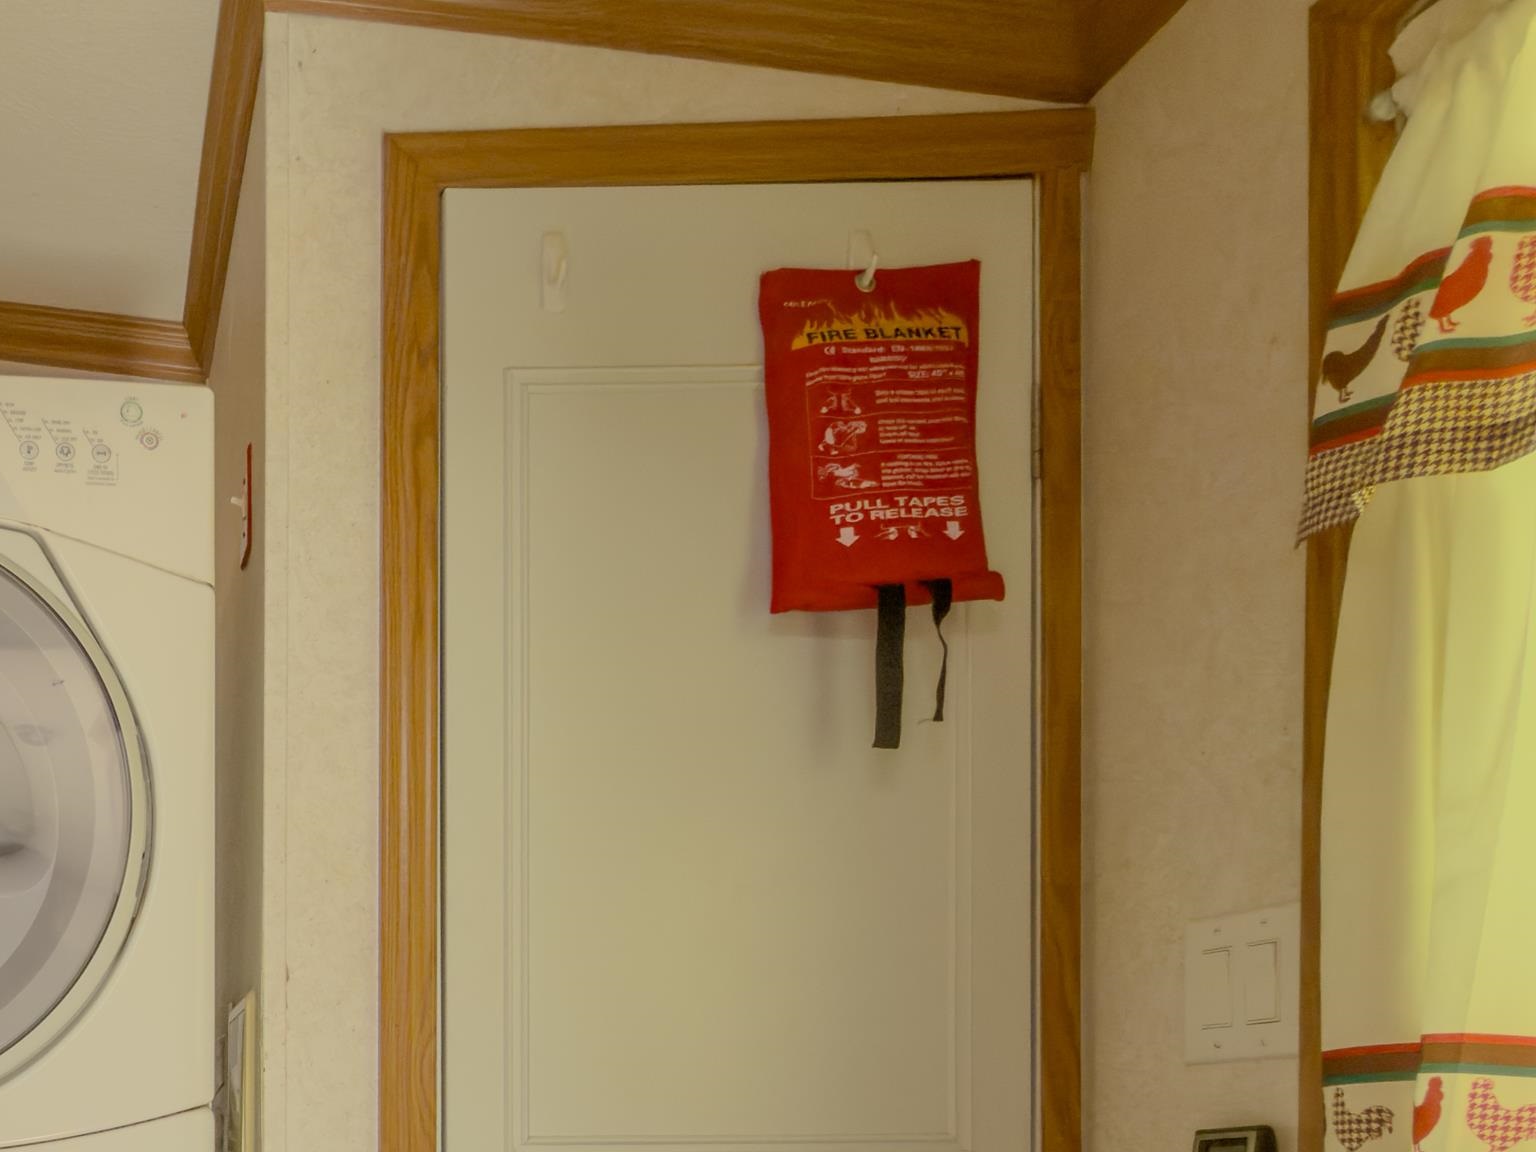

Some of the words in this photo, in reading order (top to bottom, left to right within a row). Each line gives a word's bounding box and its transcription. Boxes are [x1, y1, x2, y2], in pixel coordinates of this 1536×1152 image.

[806, 328, 857, 344] FIRE
[864, 326, 962, 341] BLANKET
[829, 498, 890, 515] PULL
[894, 495, 965, 508] TAPES
[829, 512, 864, 525] TO
[870, 506, 969, 521] RELEASE
